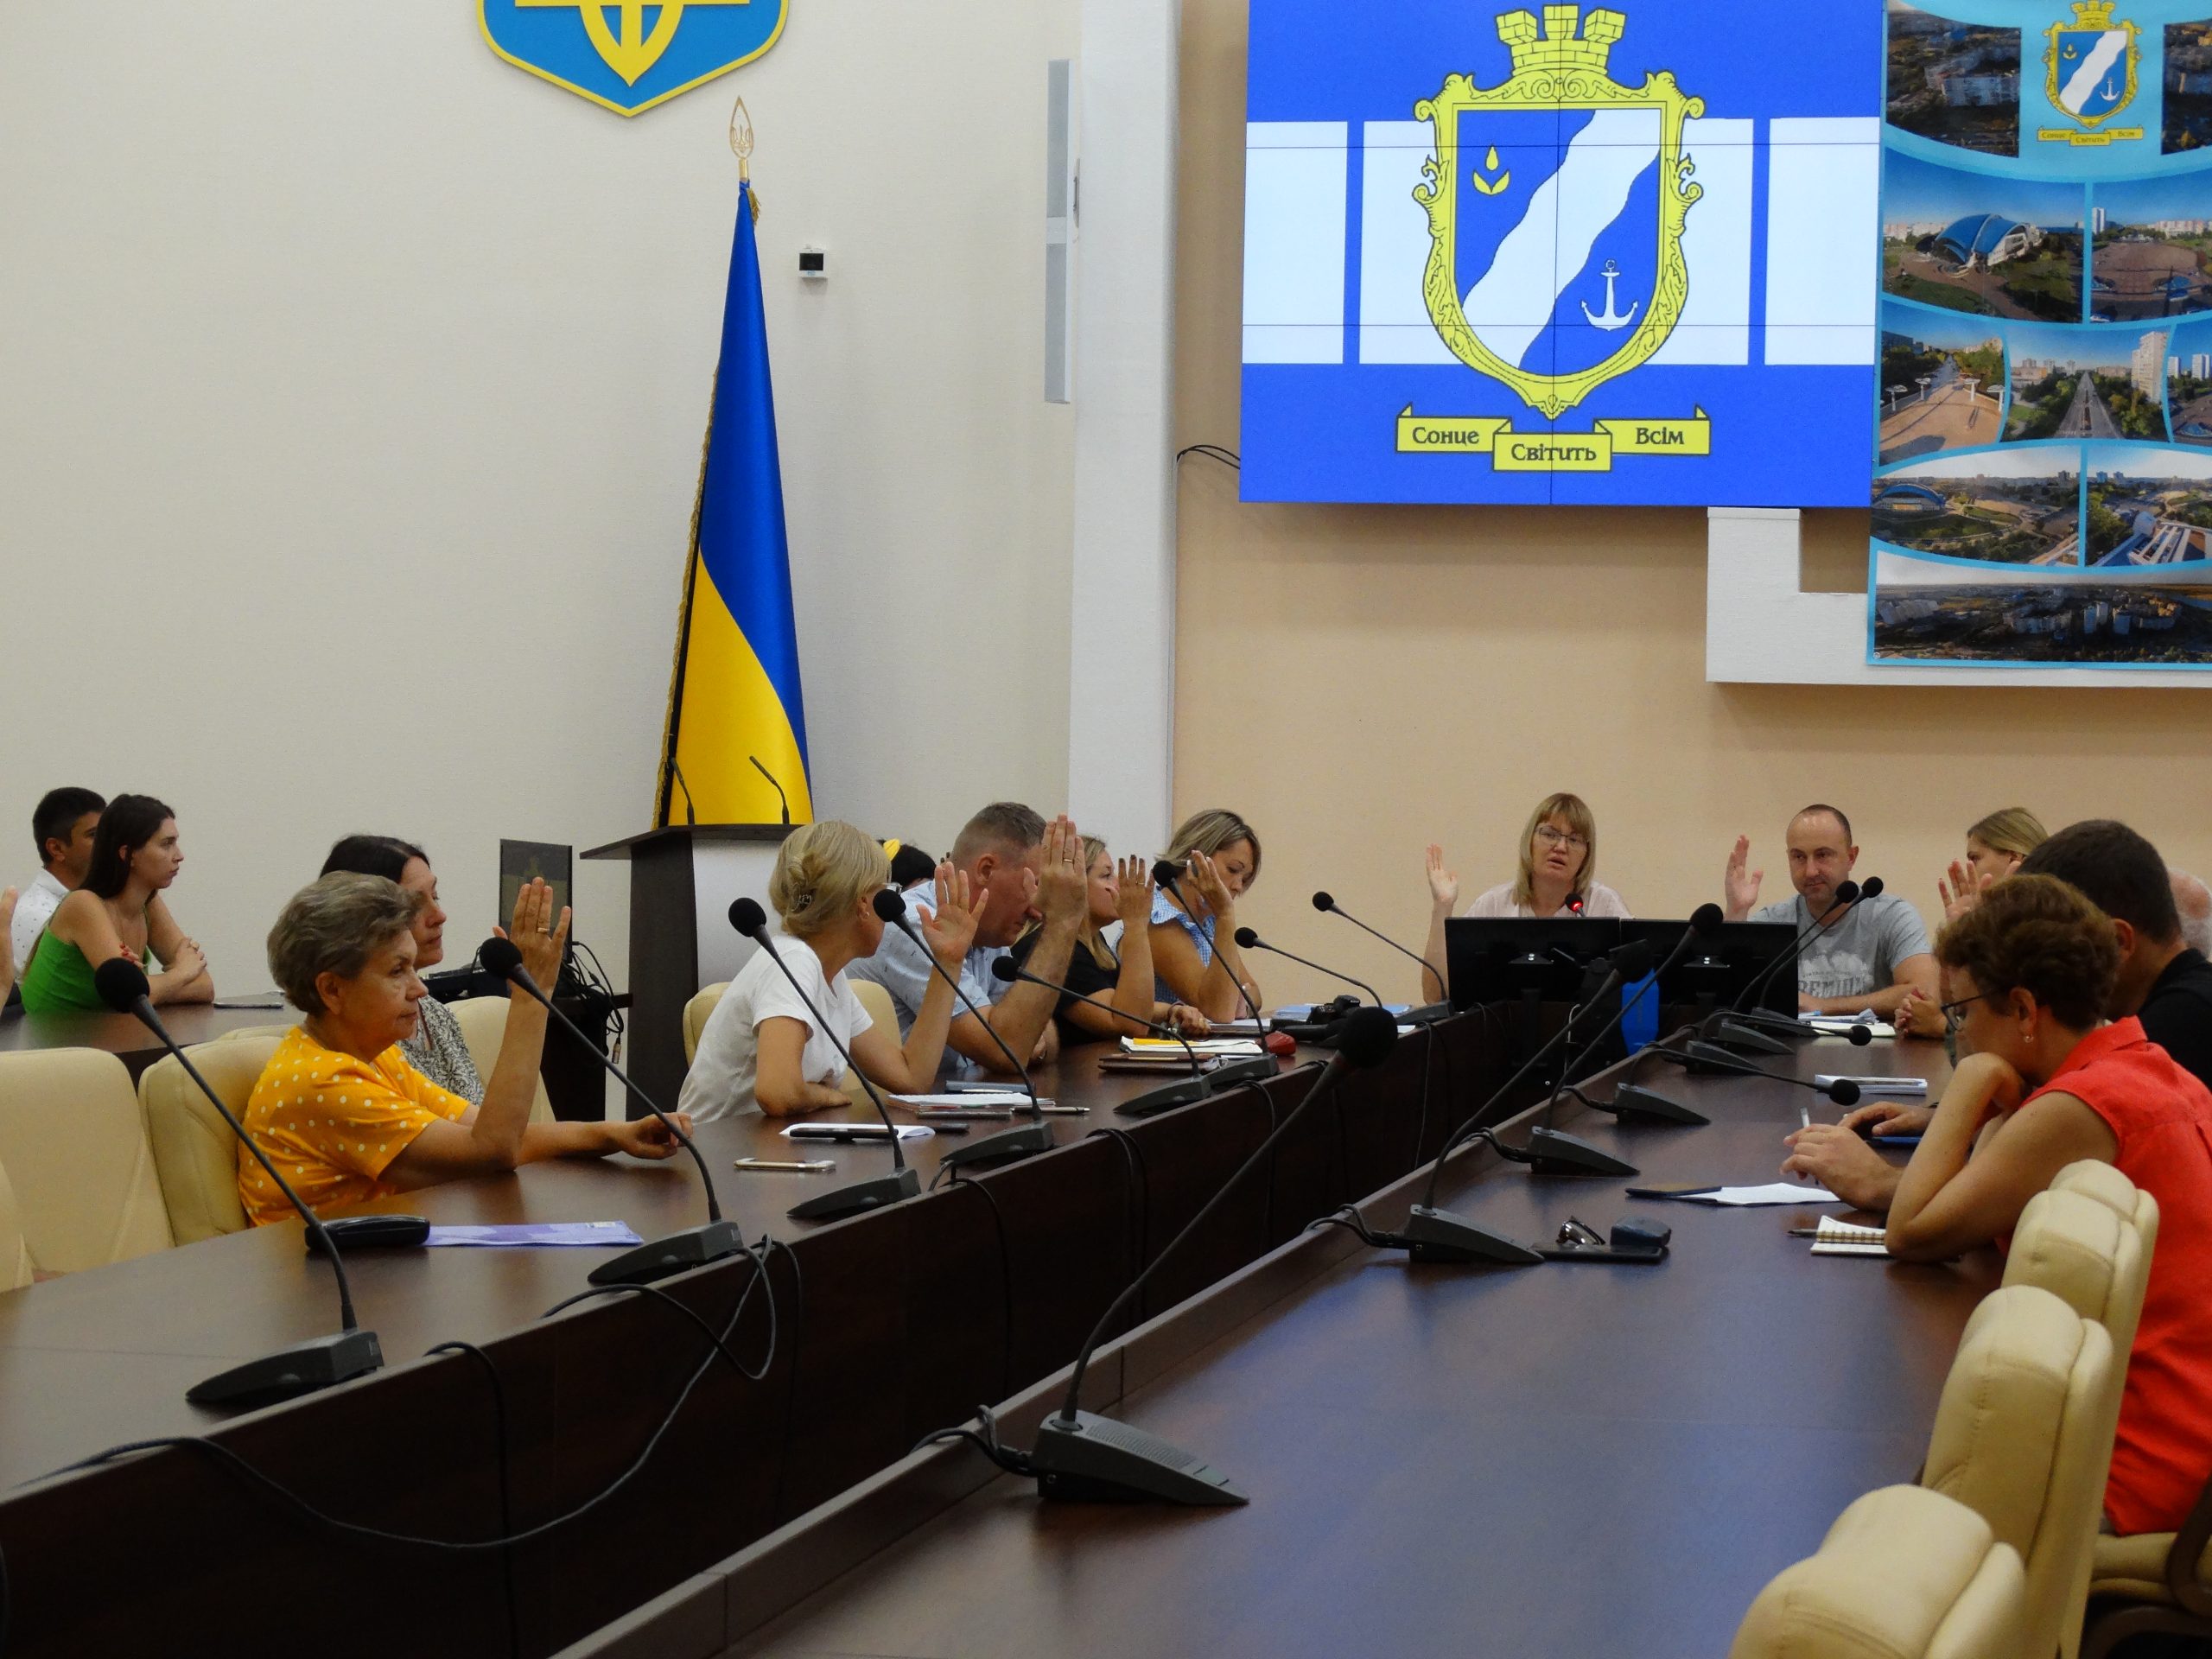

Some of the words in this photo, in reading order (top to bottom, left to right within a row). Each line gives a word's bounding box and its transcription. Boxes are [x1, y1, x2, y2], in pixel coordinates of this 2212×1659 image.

[1412, 426, 1480, 447] Сонце
[1511, 442, 1597, 461] Світить
[1635, 427, 1685, 445] Всім
